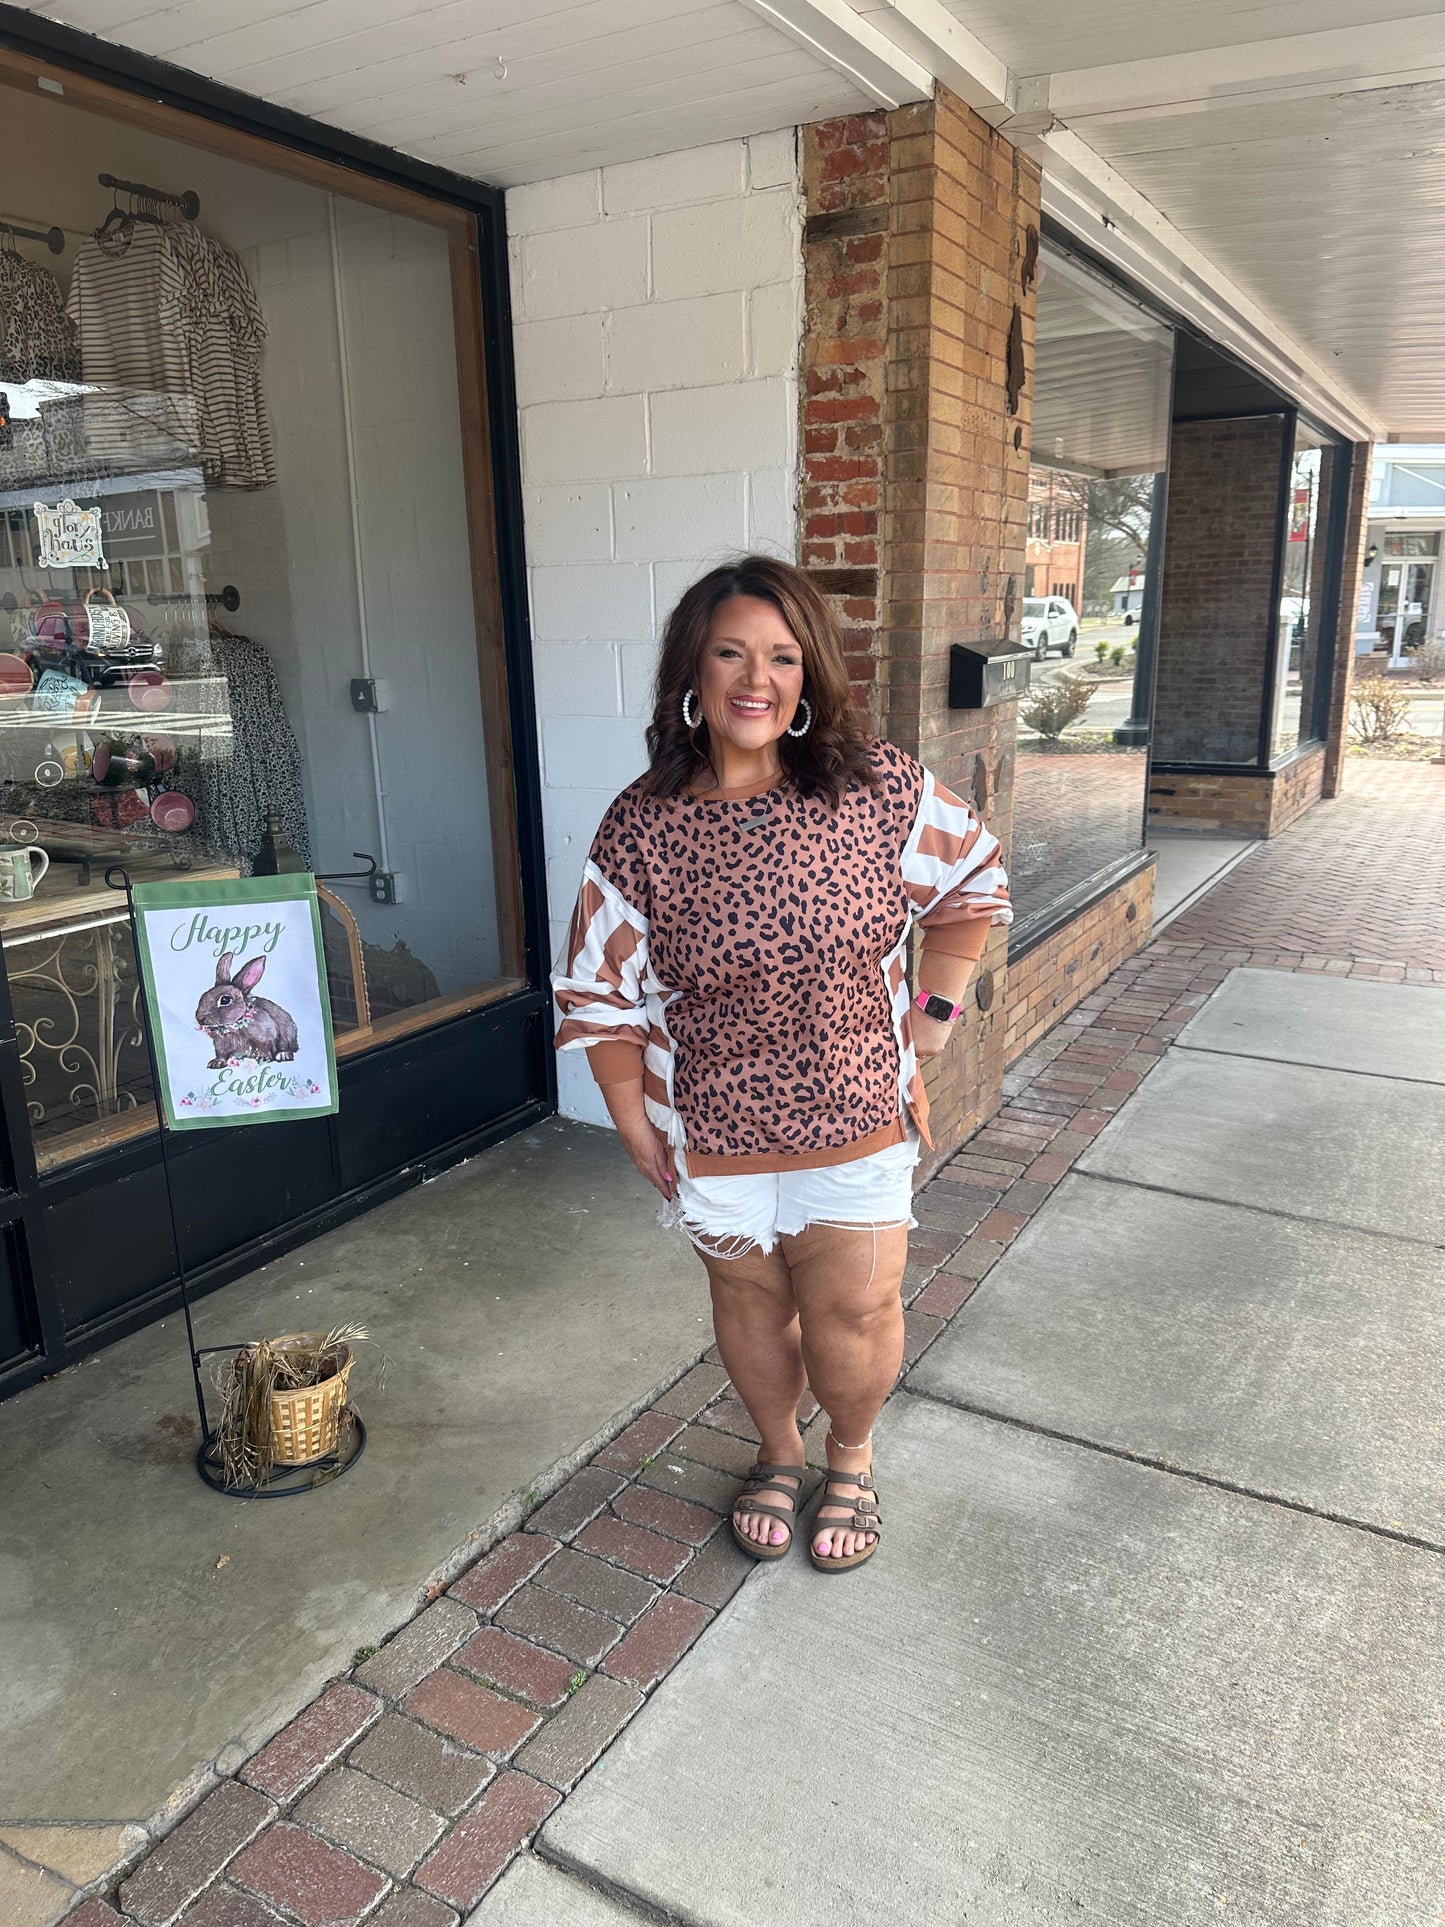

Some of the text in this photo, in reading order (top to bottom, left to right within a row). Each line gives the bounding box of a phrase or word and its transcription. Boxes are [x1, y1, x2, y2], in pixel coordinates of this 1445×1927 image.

[53, 515, 96, 538] glory
[44, 528, 94, 552] haus
[1003, 661, 1015, 680] 100
[170, 912, 286, 957] Happy
[210, 1066, 292, 1096] Easter
